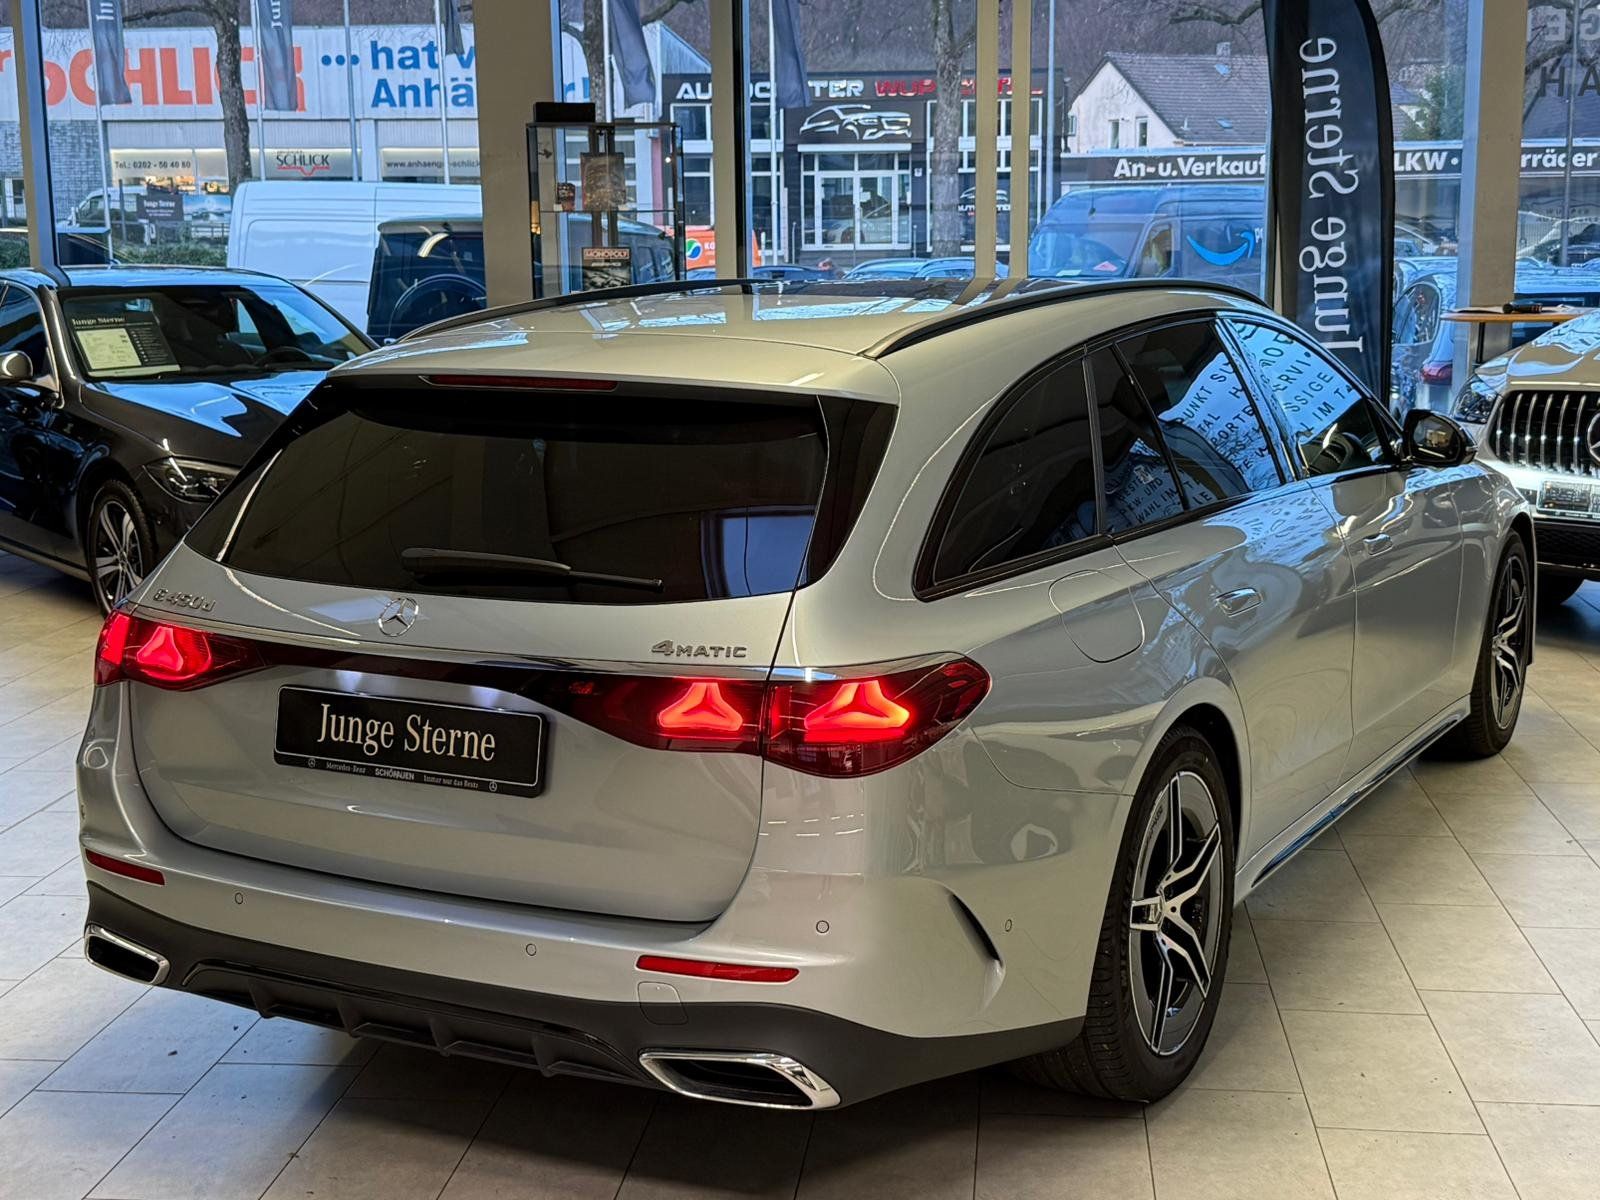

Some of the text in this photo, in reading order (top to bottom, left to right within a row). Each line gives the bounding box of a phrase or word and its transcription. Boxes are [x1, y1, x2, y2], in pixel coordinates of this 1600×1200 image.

[371, 41, 438, 70] hat
[276, 153, 331, 167] SCHLICK
[651, 639, 748, 658] 4MATIC
[316, 703, 496, 762] Junge Sterne
